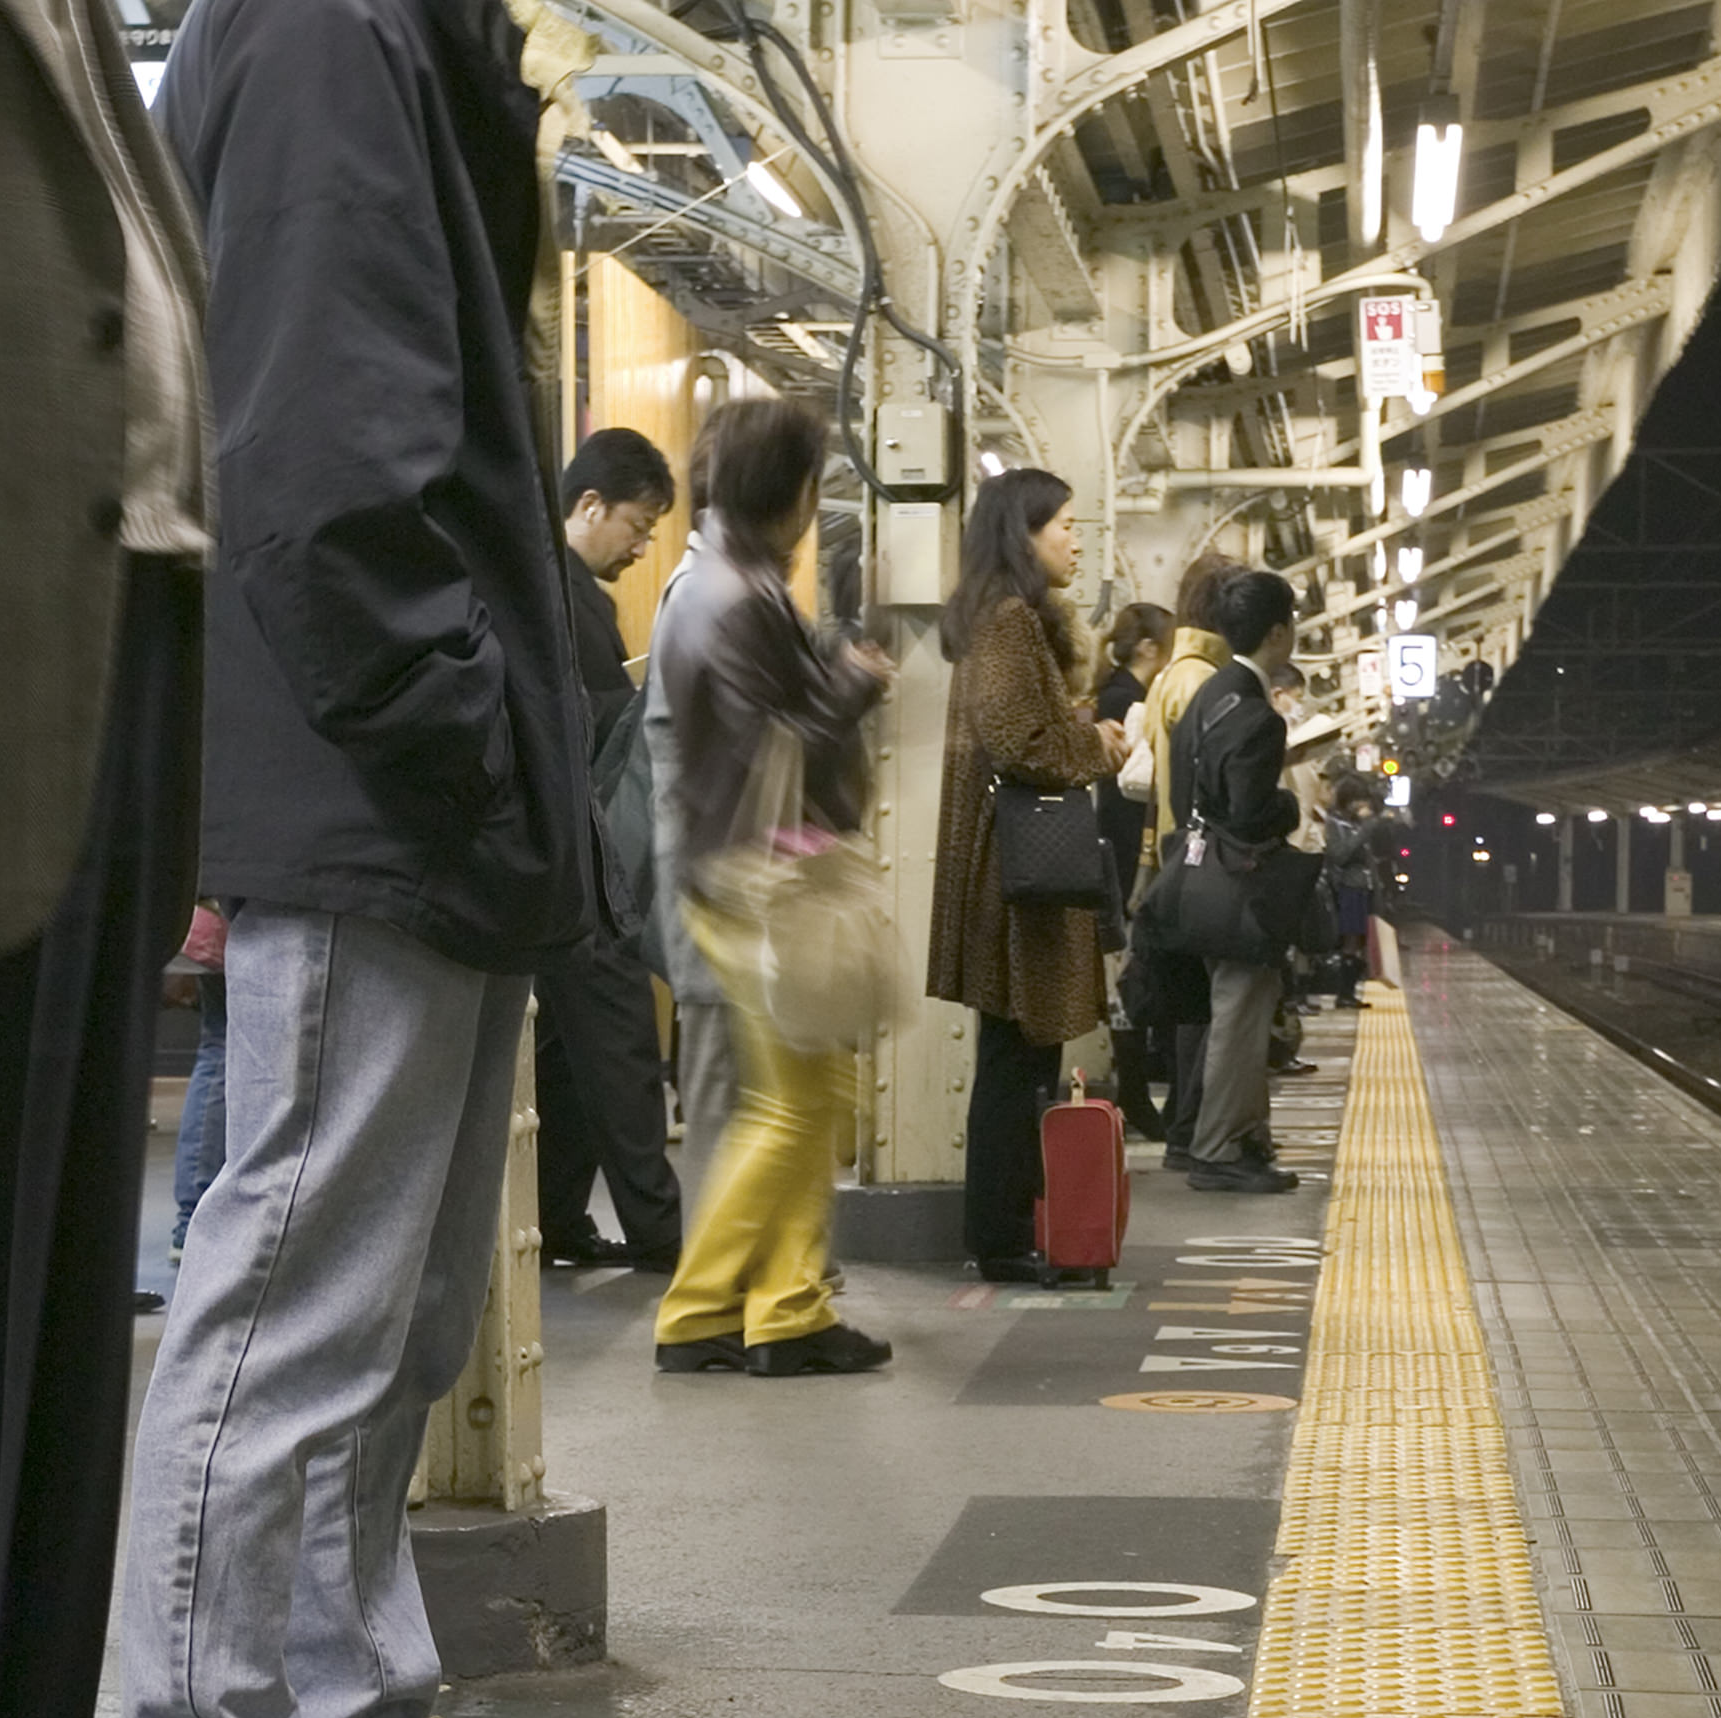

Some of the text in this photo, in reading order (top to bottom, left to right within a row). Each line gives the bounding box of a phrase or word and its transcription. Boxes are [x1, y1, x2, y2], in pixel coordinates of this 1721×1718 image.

[1366, 302, 1401, 317] SOS
[1399, 646, 1424, 686] 5
[1211, 1344, 1301, 1355] 6
[1096, 1630, 1243, 1653] 4
